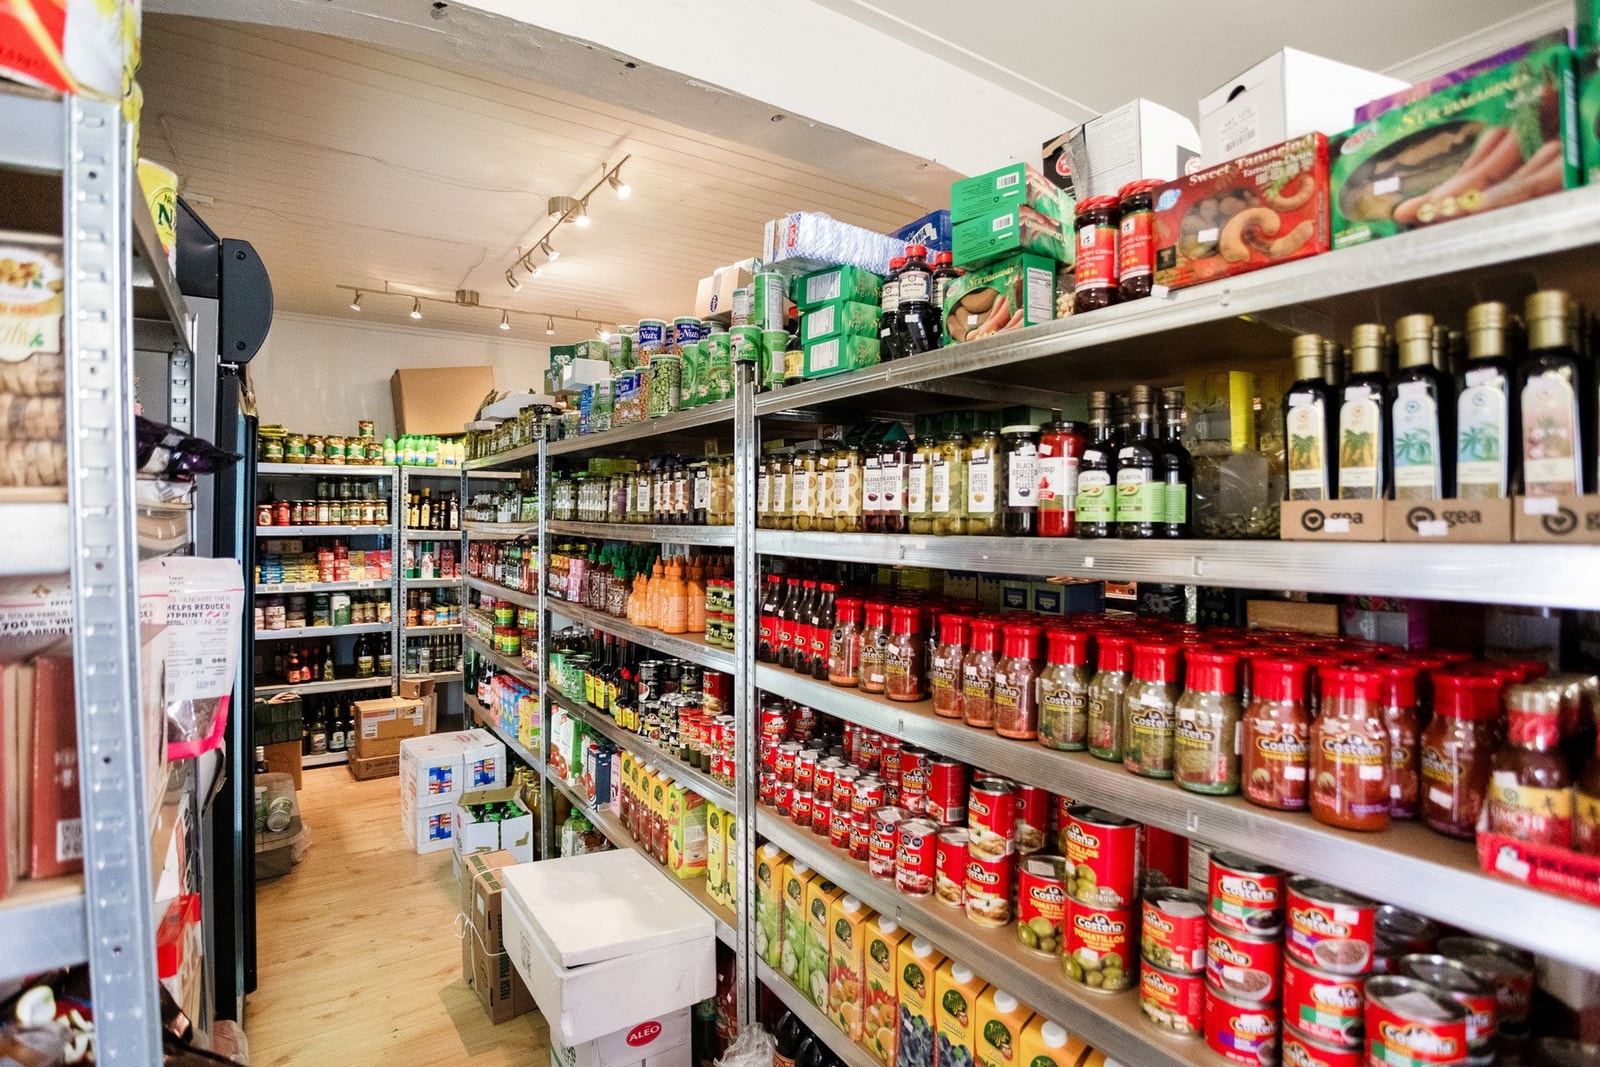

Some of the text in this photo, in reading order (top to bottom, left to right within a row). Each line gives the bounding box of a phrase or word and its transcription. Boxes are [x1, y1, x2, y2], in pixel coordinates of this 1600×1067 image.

[1189, 165, 1230, 186] Sweet
[1235, 134, 1313, 169] Tamarind
[641, 331, 658, 340] Nuts
[682, 329, 699, 338] Nuts
[1443, 508, 1482, 527] gea
[194, 603, 225, 611] REDUCE
[1282, 735, 1294, 743] La
[1072, 825, 1080, 834] La
[973, 864, 981, 872] La
[1242, 880, 1256, 890] La
[1050, 887, 1059, 895] La
[1095, 915, 1106, 923] La
[1310, 912, 1322, 922] La
[1074, 928, 1125, 944] TOMATILLOS
[629, 1025, 660, 1042] ALEO
